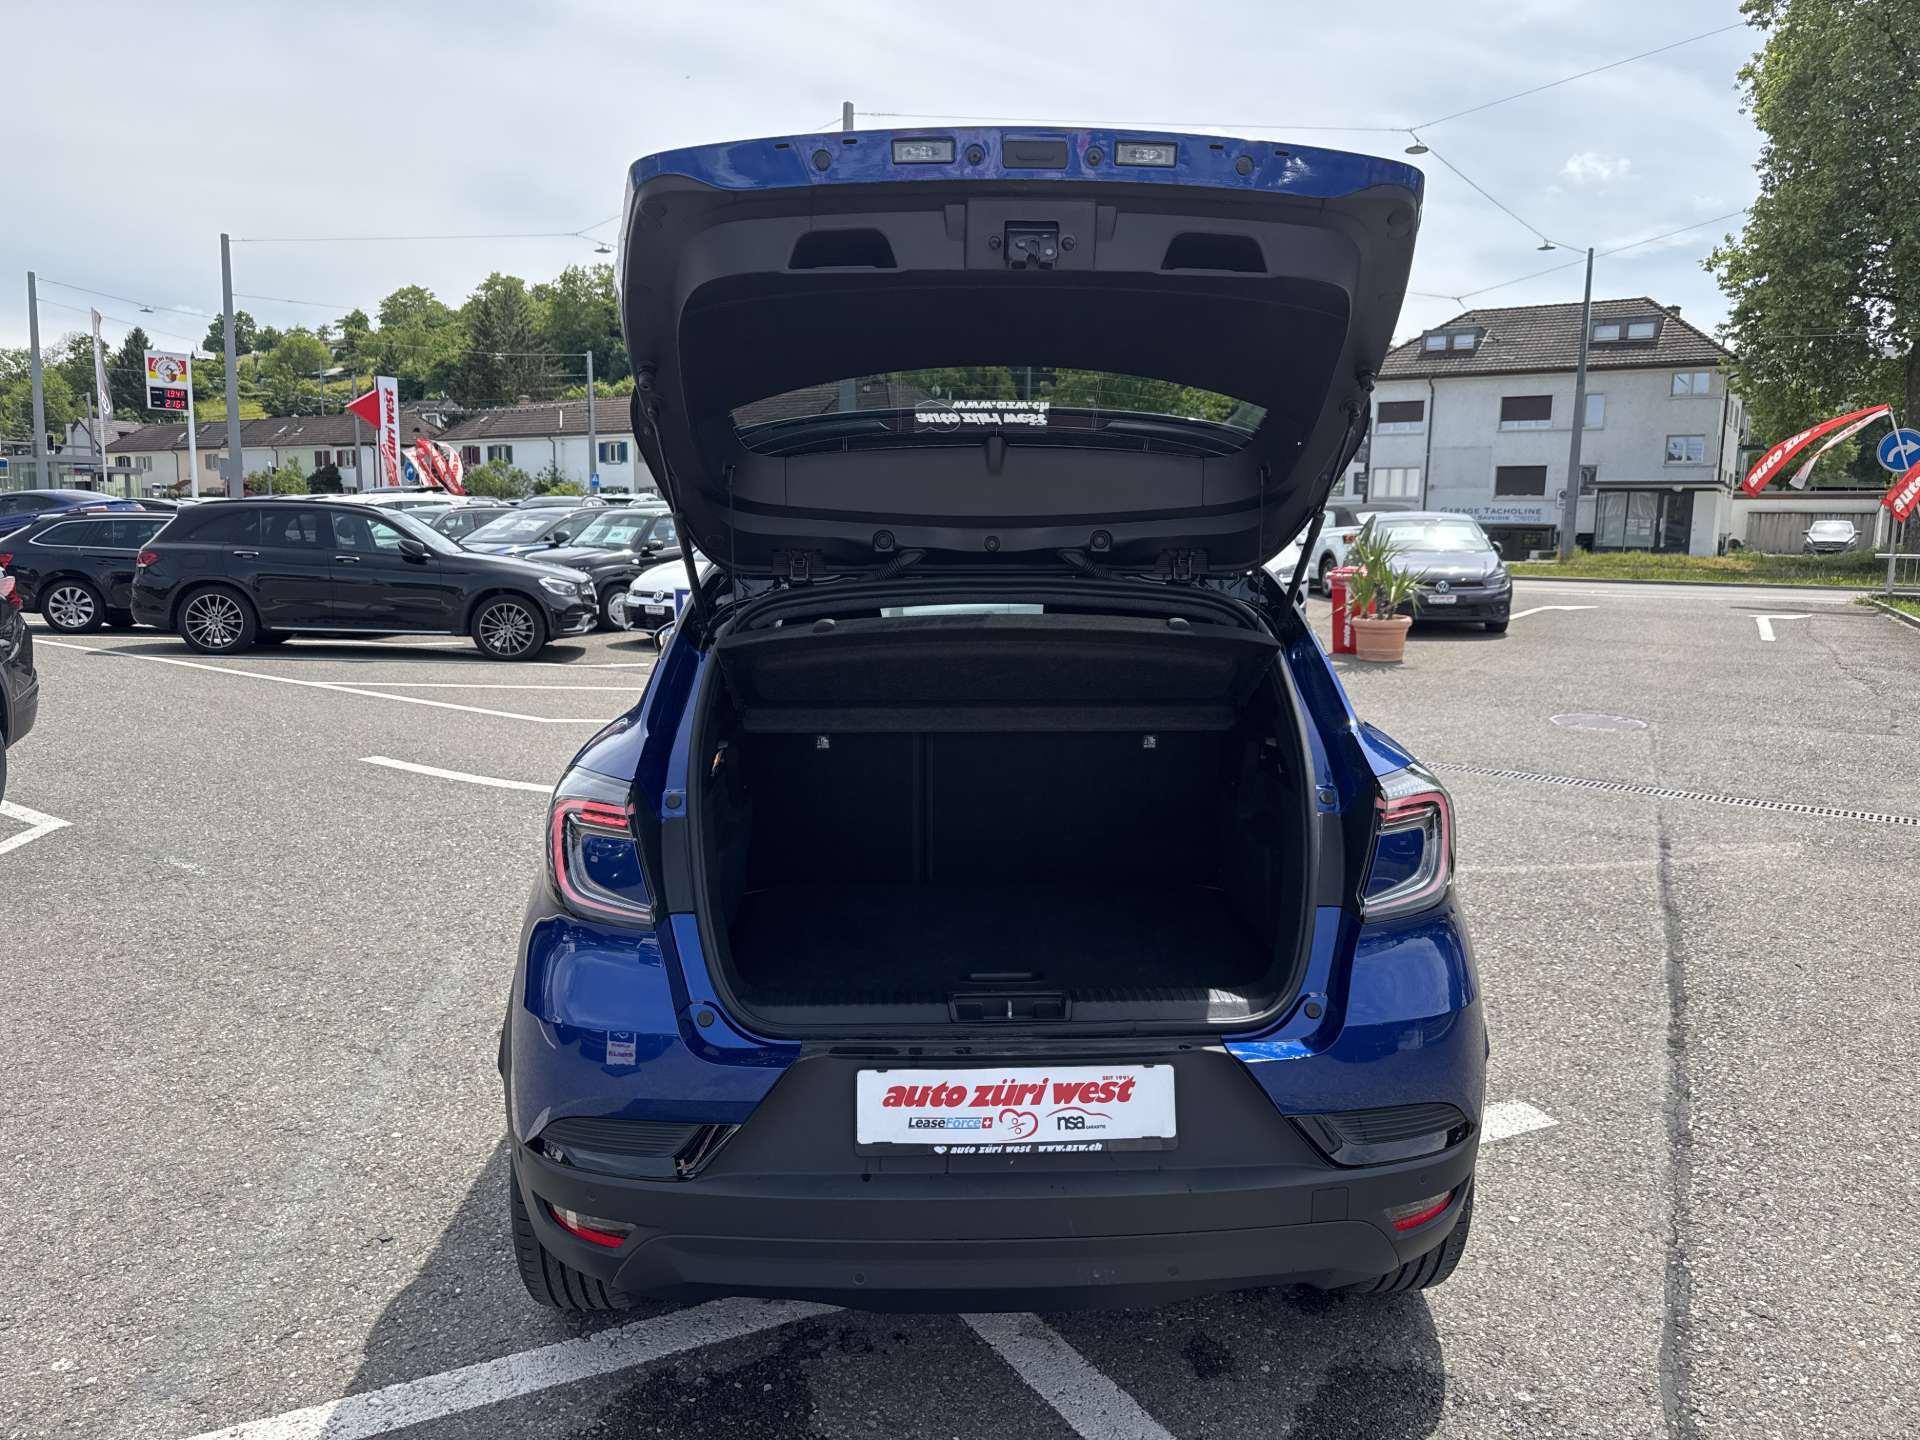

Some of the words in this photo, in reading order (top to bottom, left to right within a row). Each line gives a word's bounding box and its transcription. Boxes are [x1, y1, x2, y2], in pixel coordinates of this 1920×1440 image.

[1749, 449, 1783, 488] auto
[1484, 507, 1542, 515] TACHOLINE
[882, 1080, 967, 1107] auto
[968, 1077, 1049, 1107] züri
[1053, 1076, 1136, 1104] west
[908, 1117, 981, 1129] LeaseForce
[1057, 1116, 1085, 1130] nsa
[950, 1145, 976, 1154] auto
[978, 1144, 1003, 1154] züri
[1006, 1144, 1031, 1153] west
[1038, 1142, 1103, 1152] www.azw.ch
